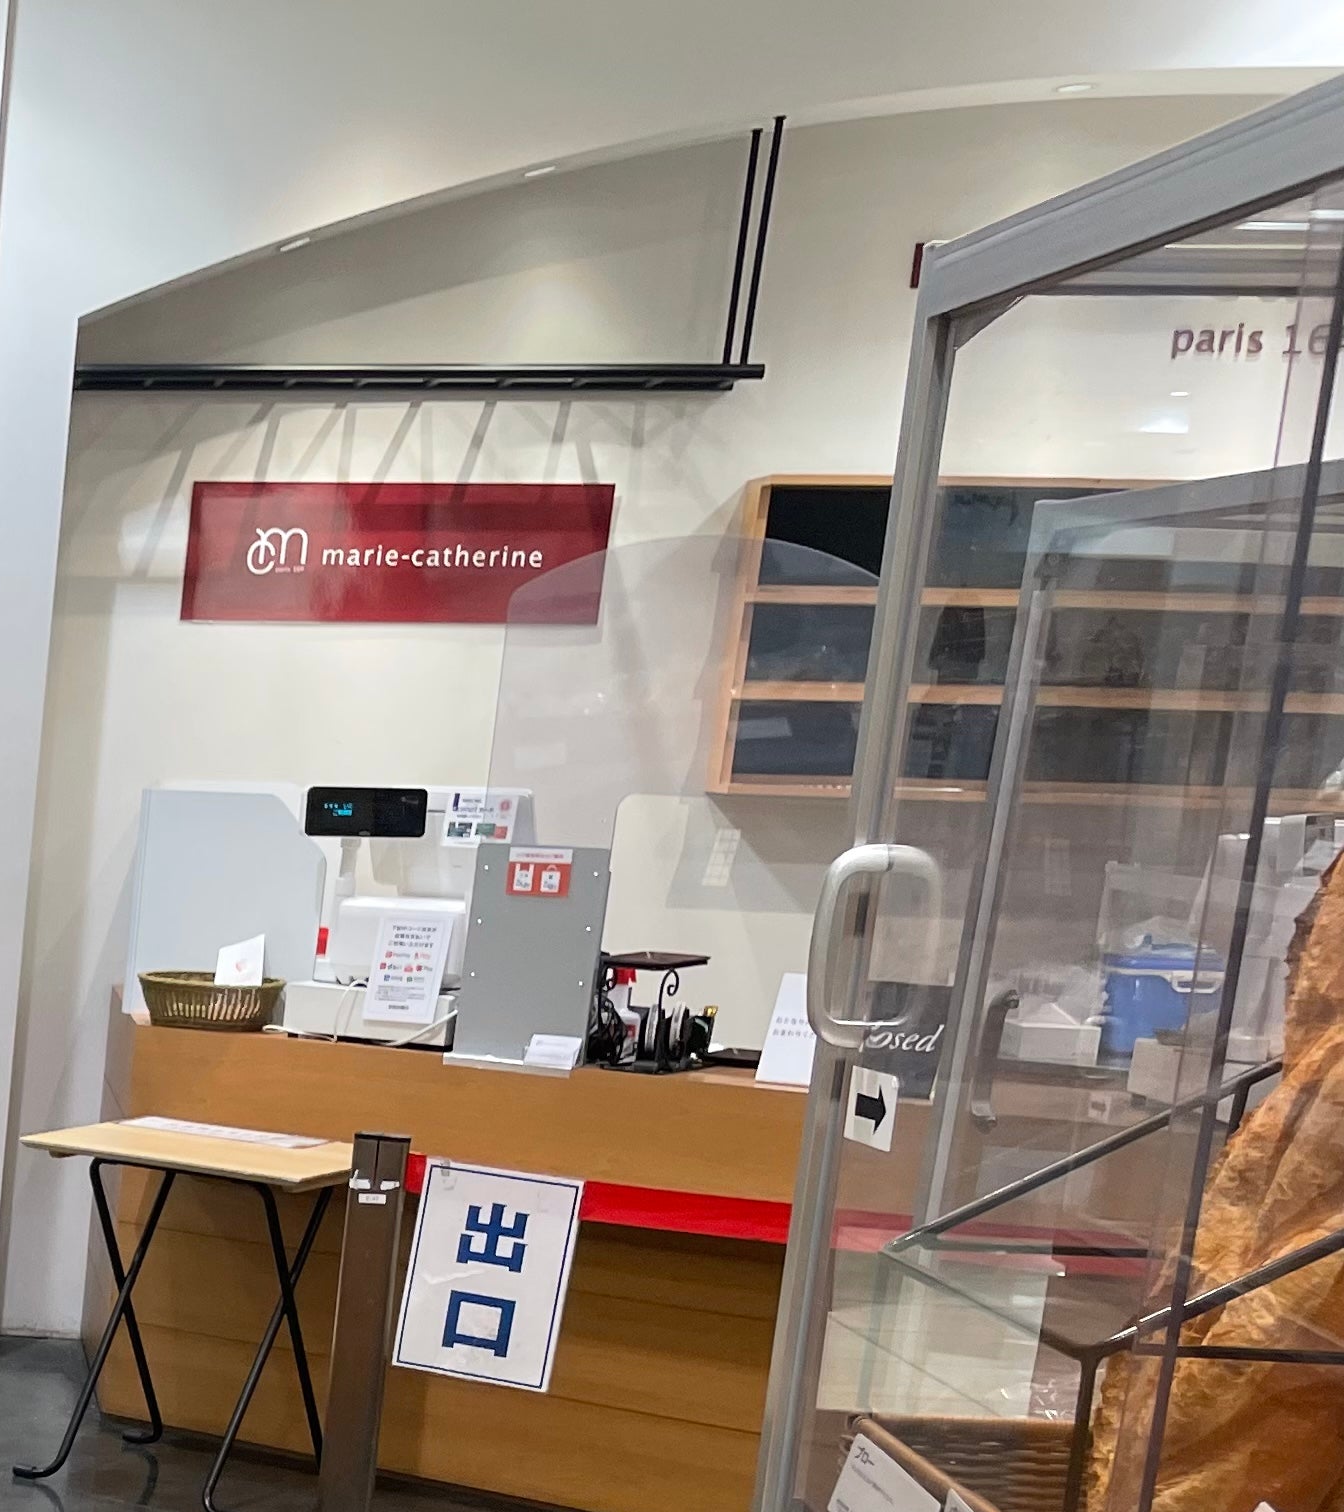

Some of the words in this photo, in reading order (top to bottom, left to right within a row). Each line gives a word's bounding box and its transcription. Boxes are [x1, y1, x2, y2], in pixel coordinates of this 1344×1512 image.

[1171, 322, 1263, 360] paris
[321, 544, 544, 568] marie-catherine
[442, 1203, 530, 1358] 出口
